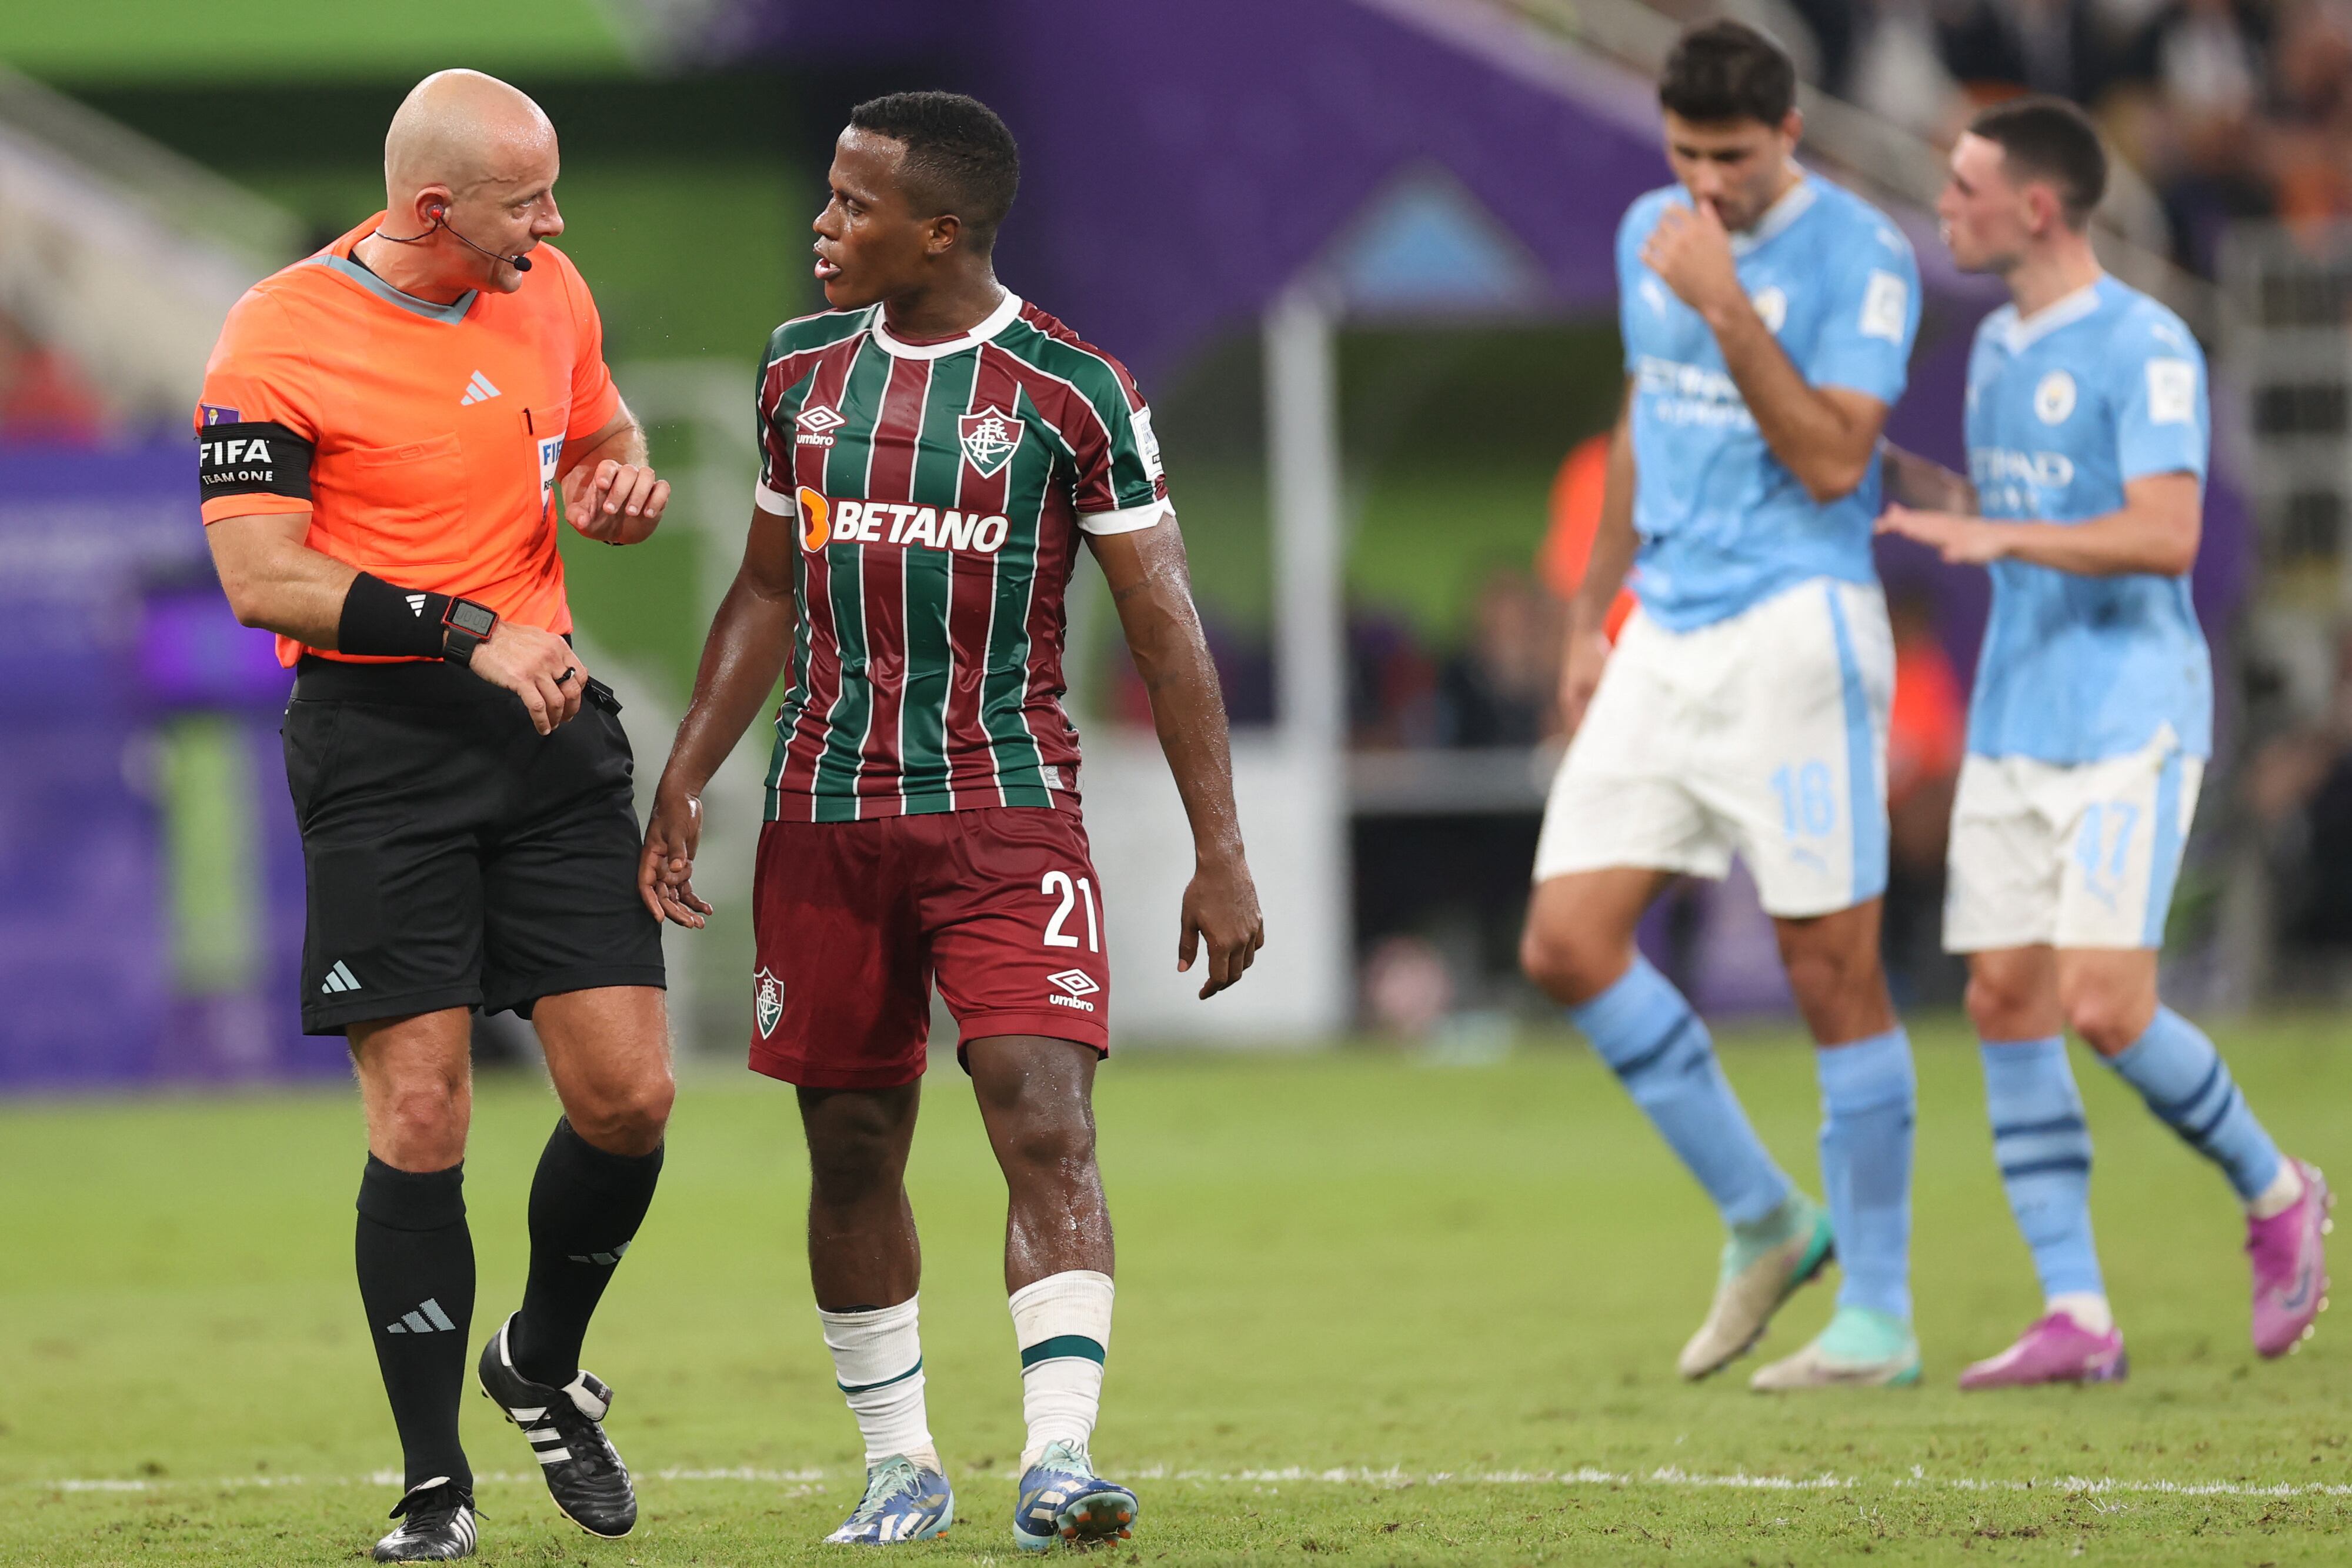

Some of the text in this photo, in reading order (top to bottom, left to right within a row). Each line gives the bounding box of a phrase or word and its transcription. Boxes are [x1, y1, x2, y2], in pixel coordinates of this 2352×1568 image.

[796, 432, 834, 446] umbro
[200, 439, 272, 468] FIFA
[543, 441, 563, 466] FIF
[202, 471, 273, 485] TEAM ONE
[833, 501, 1009, 553] BETANO
[1042, 870, 1099, 953] 21
[1049, 994, 1094, 1012] umbro
